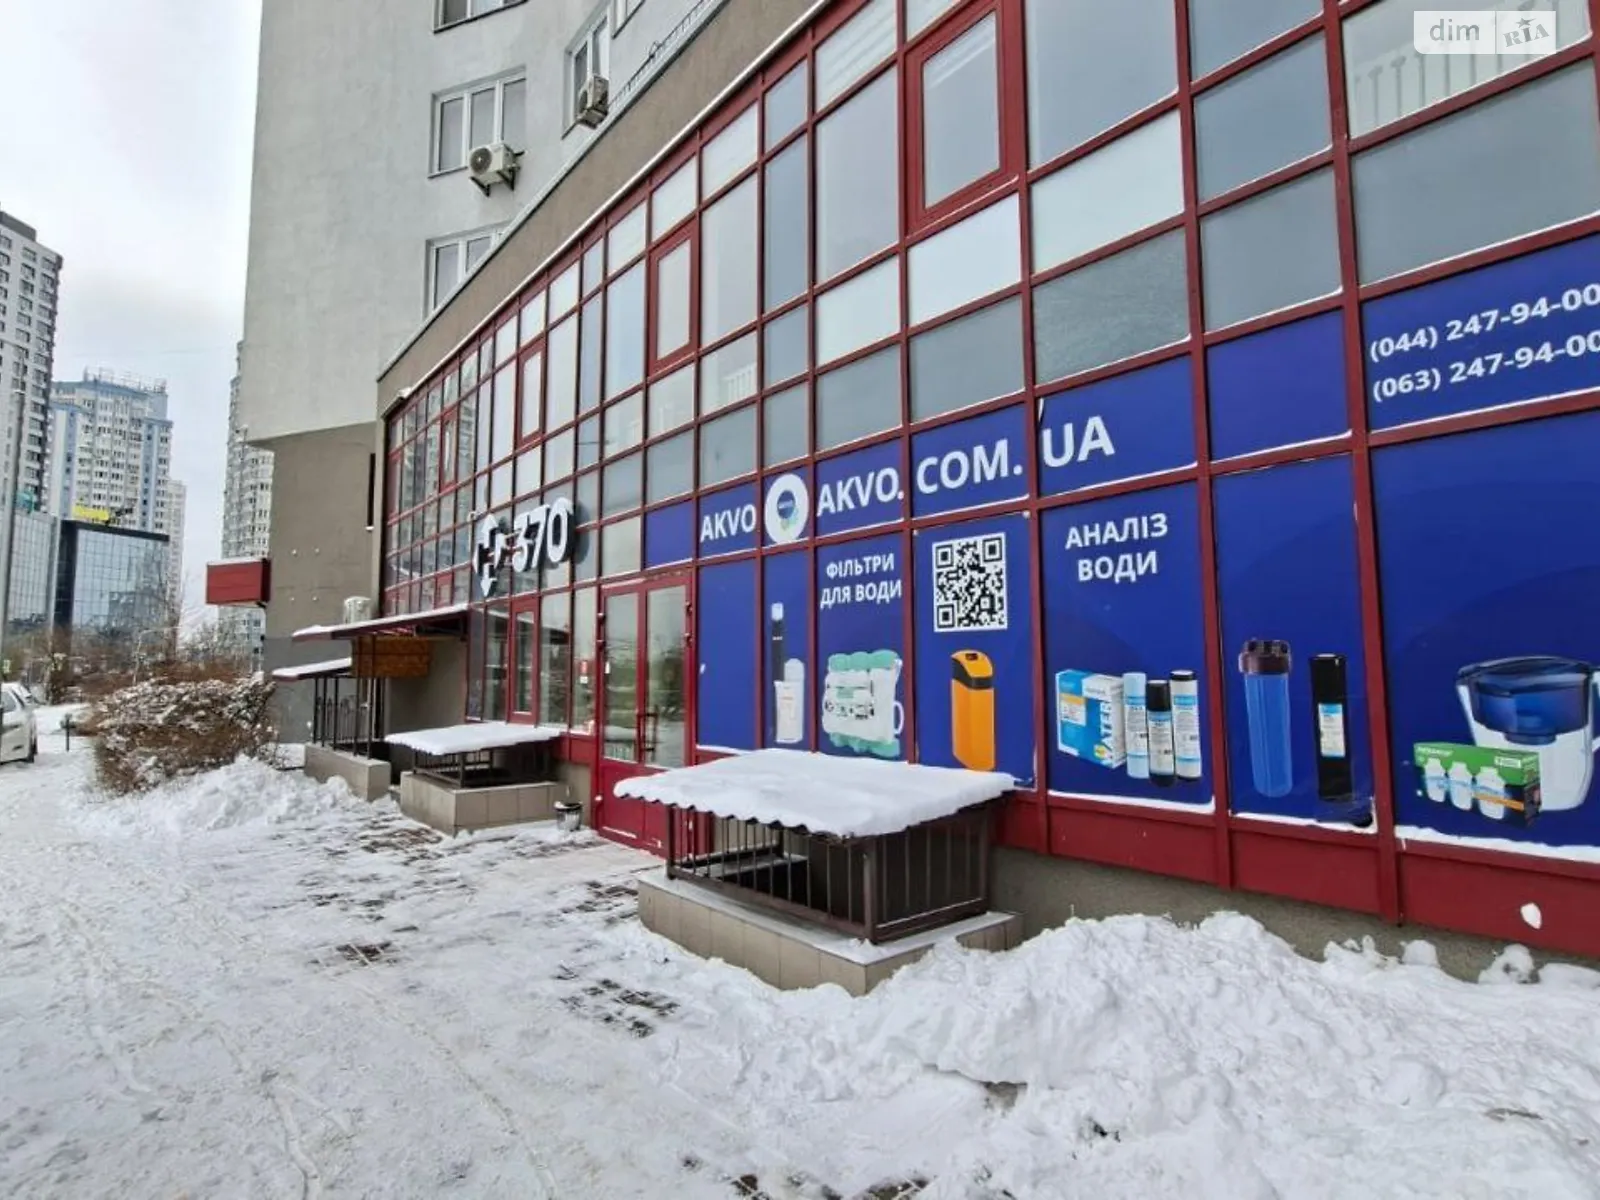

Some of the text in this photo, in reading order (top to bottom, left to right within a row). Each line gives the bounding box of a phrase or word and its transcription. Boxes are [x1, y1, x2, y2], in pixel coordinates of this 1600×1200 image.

[1370, 284, 1600, 362] (044) 247-94-00
[1373, 368, 1441, 402] (063)
[700, 504, 757, 543] AKVO
[1042, 415, 1115, 467] UA
[512, 497, 573, 572] 370
[1065, 513, 1168, 549] АНАЛІЗ
[826, 553, 894, 579] ФІЛЬТРИ
[1078, 550, 1157, 584] ВОДИ
[820, 579, 902, 609] ДЛЯ ВОДИ
